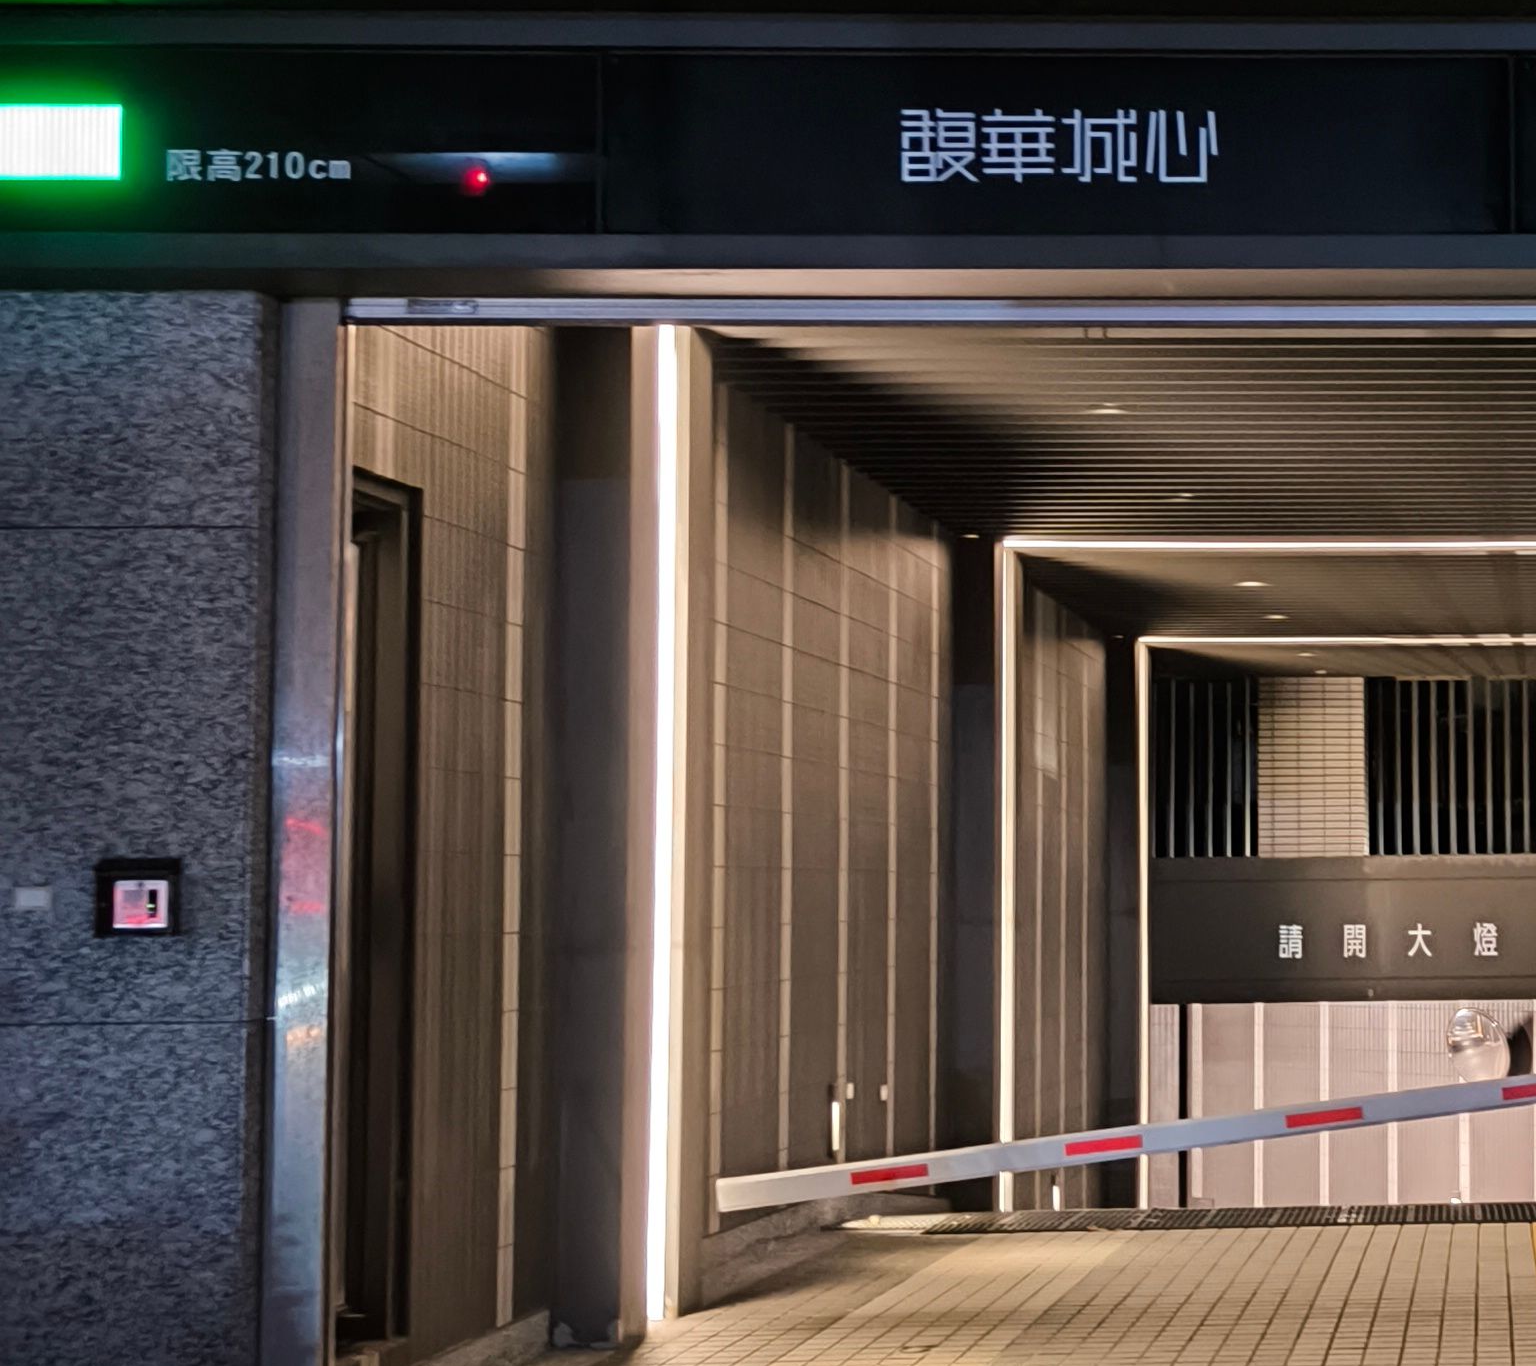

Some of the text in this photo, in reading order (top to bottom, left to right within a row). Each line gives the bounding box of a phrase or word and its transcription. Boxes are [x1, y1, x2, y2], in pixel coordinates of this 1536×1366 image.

[900, 108, 1219, 183] 馥華城心
[166, 148, 351, 182] 限高210cm
[1279, 922, 1499, 959] 請開大燈
